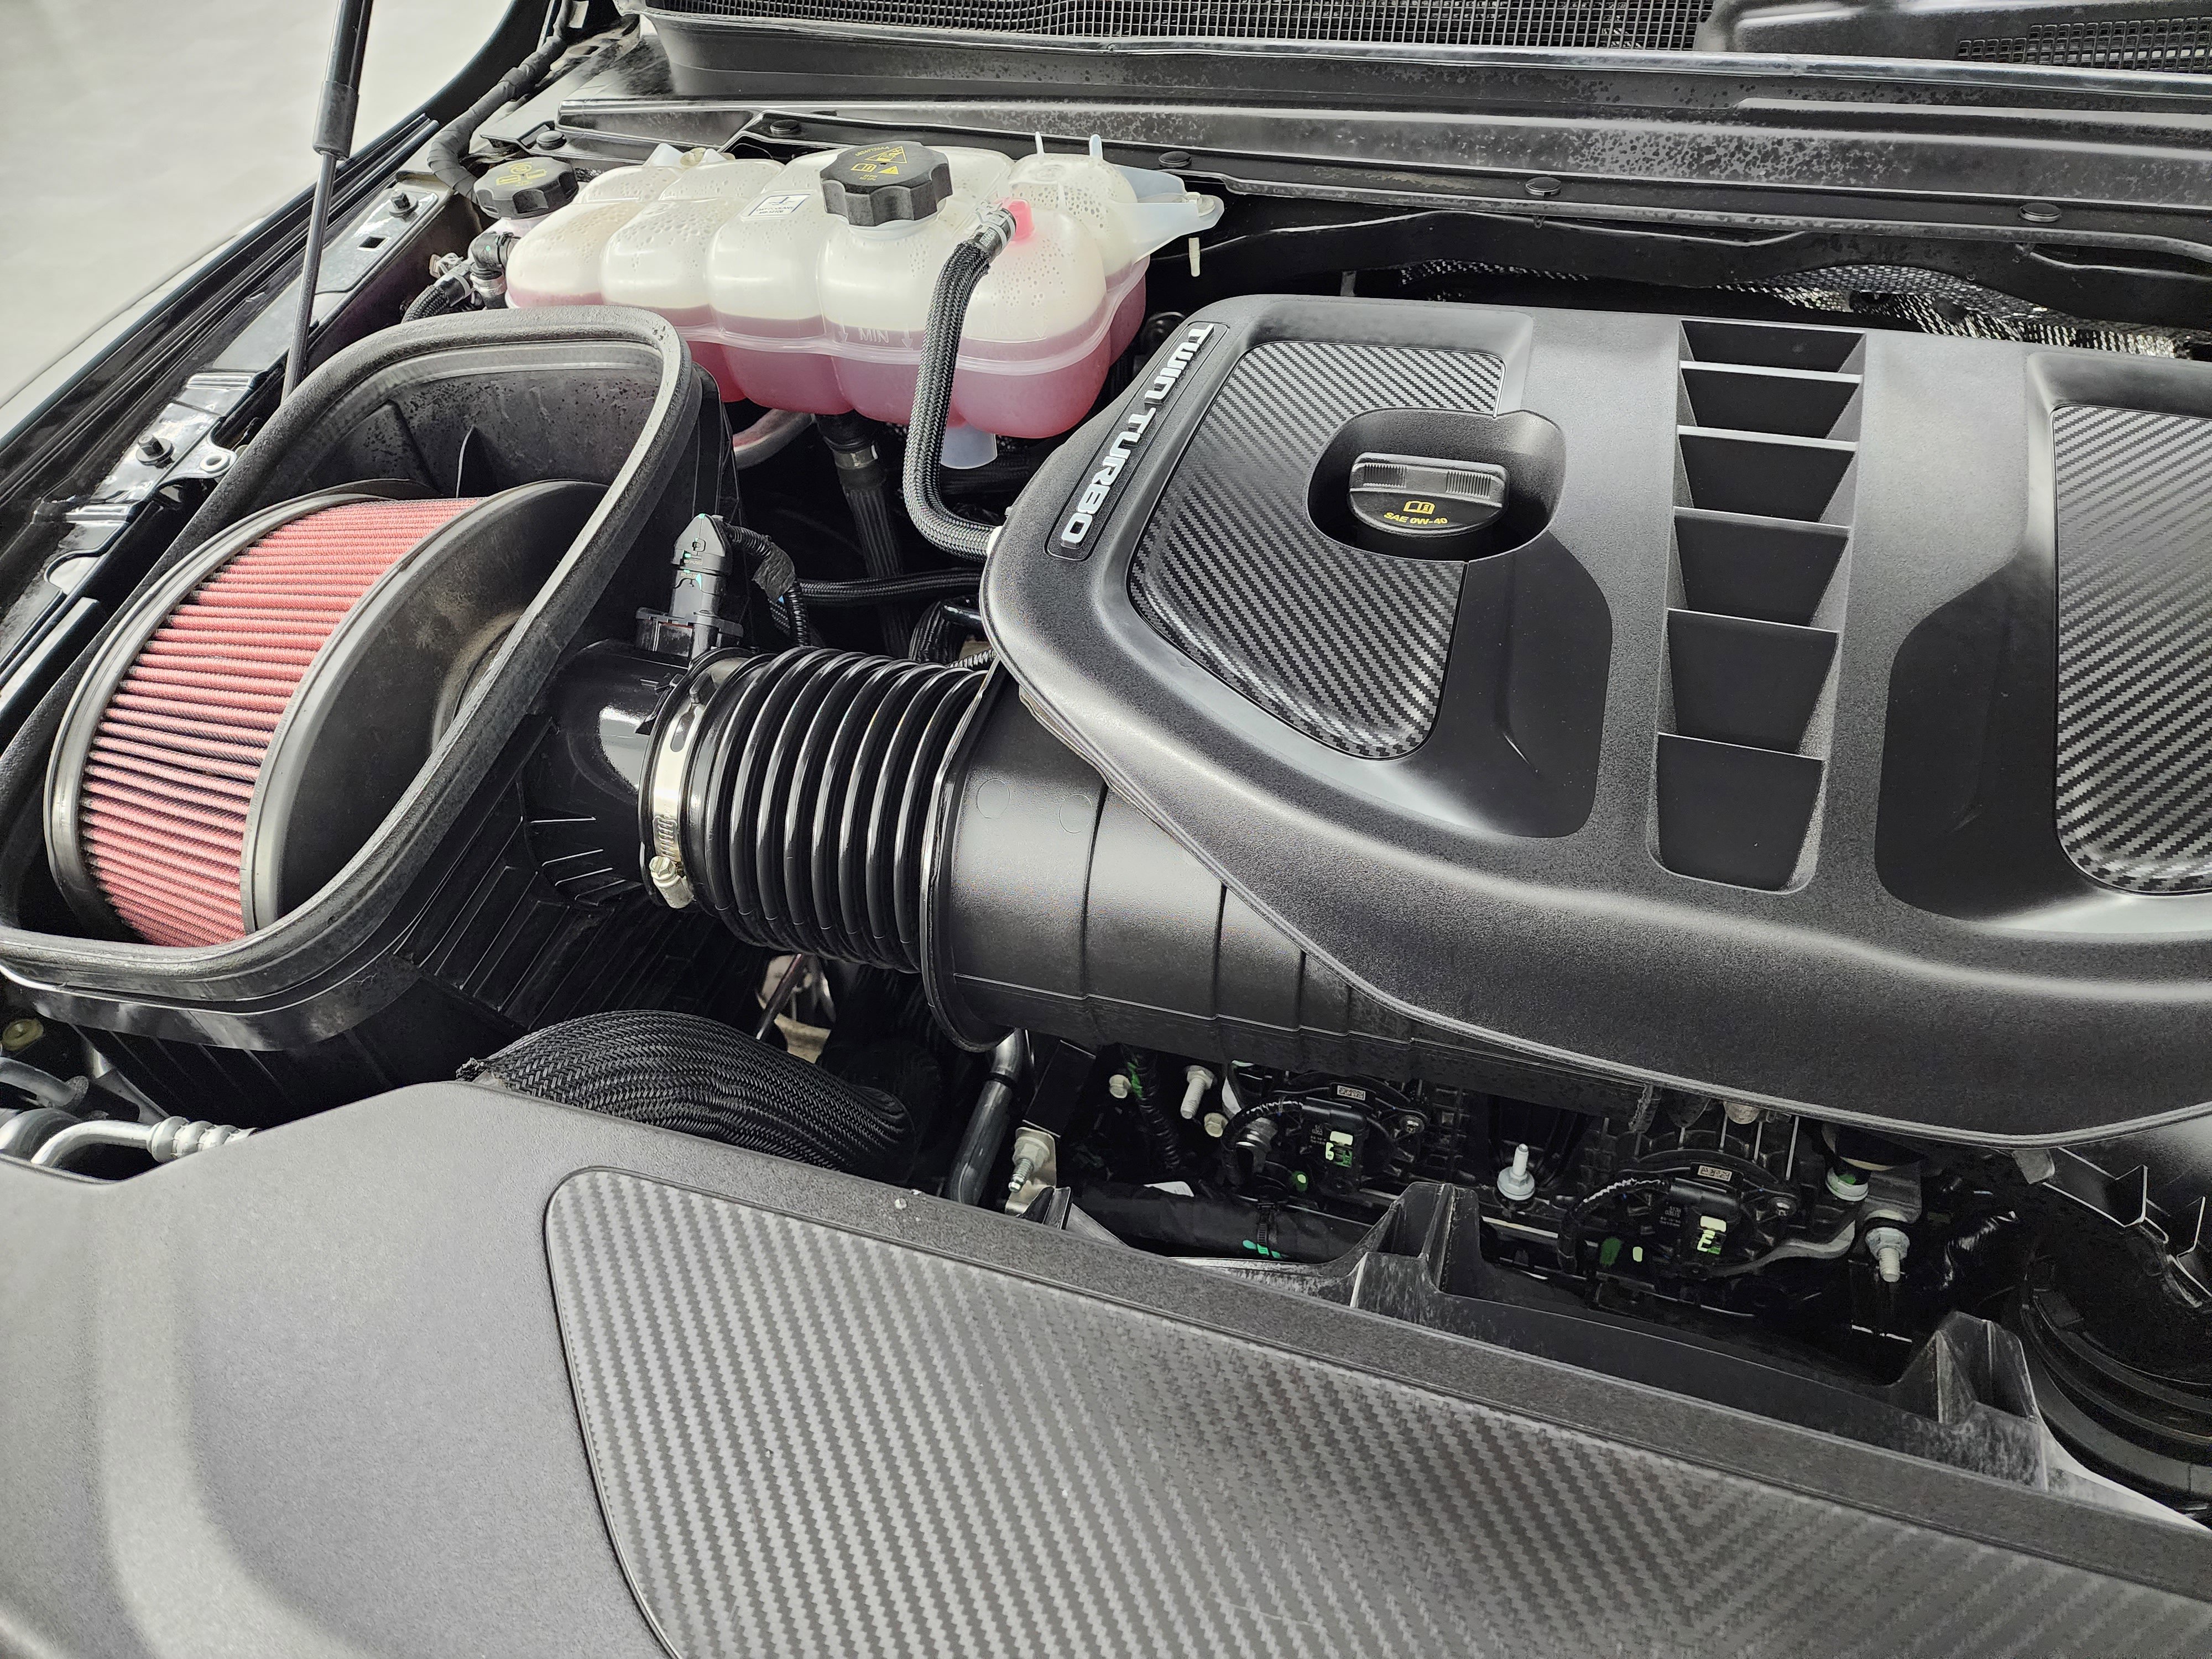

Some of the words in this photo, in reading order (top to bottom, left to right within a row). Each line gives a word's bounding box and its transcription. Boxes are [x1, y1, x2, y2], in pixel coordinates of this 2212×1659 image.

[858, 327, 890, 343] MIN
[1061, 407, 1156, 546] TURBO
[1384, 512, 1409, 523] SAE
